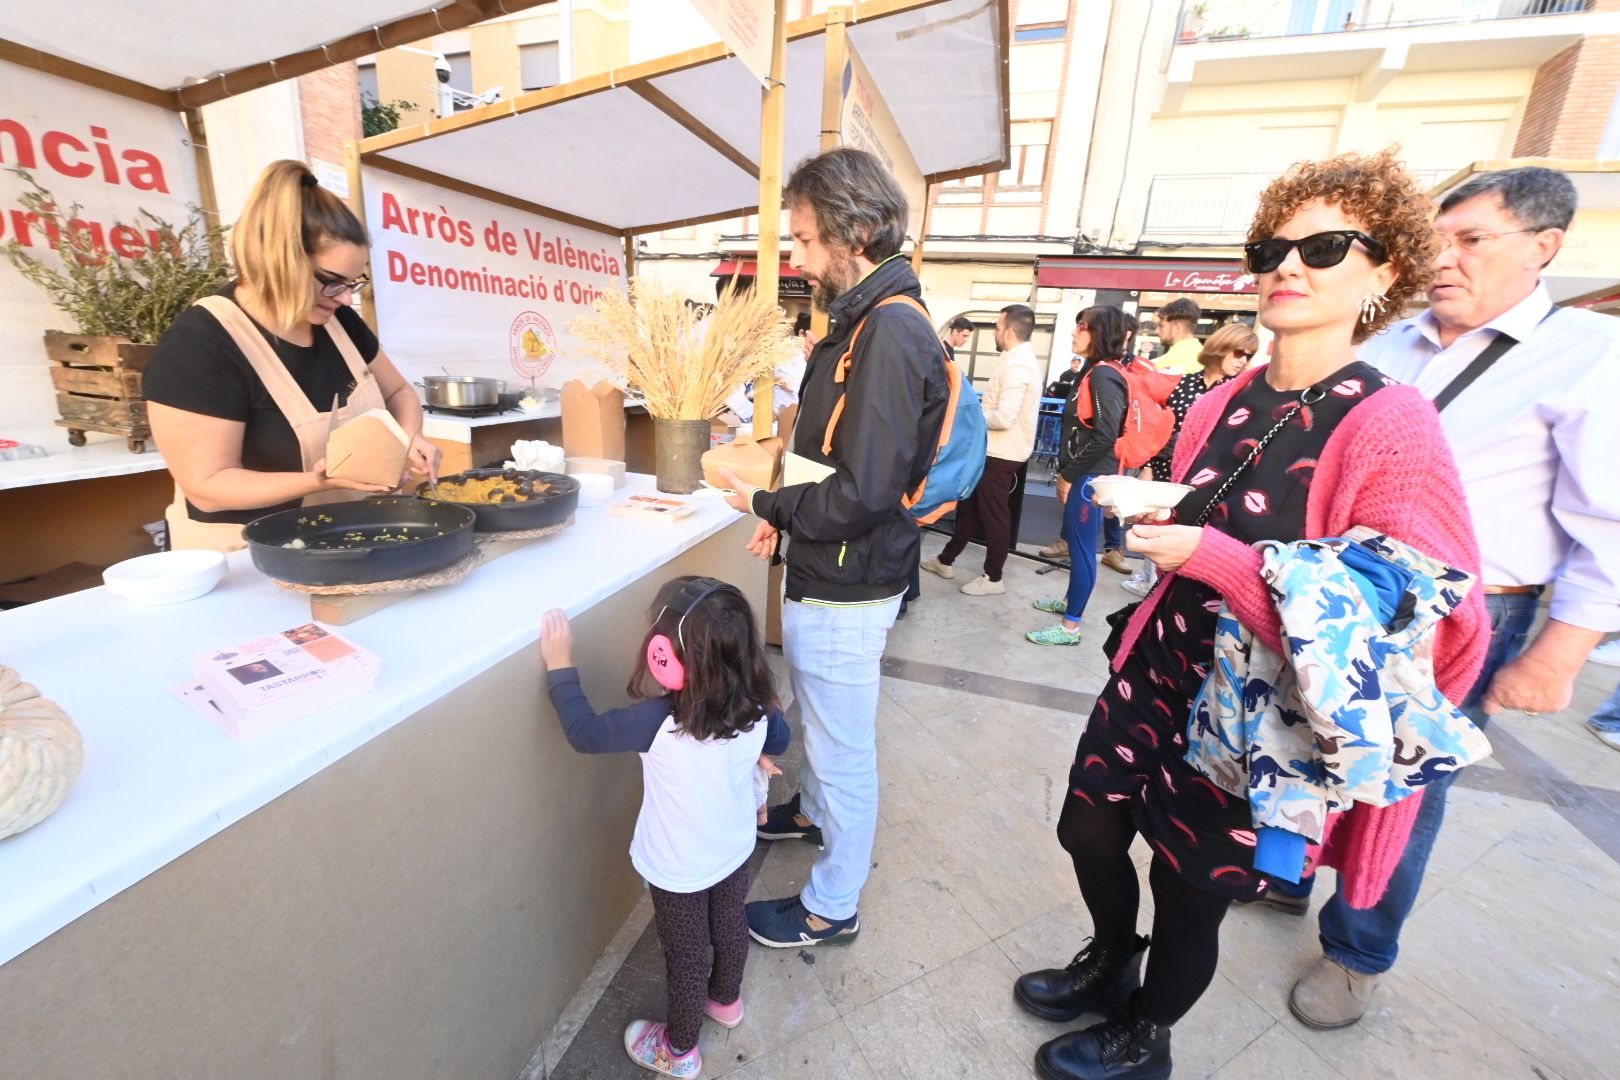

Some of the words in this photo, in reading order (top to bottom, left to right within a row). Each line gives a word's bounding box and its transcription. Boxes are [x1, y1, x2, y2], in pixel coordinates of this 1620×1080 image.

[0, 202, 182, 267] rigen
[382, 192, 475, 247] Arròs
[484, 220, 518, 256] de
[524, 229, 620, 276] València
[387, 250, 547, 301] Denominació
